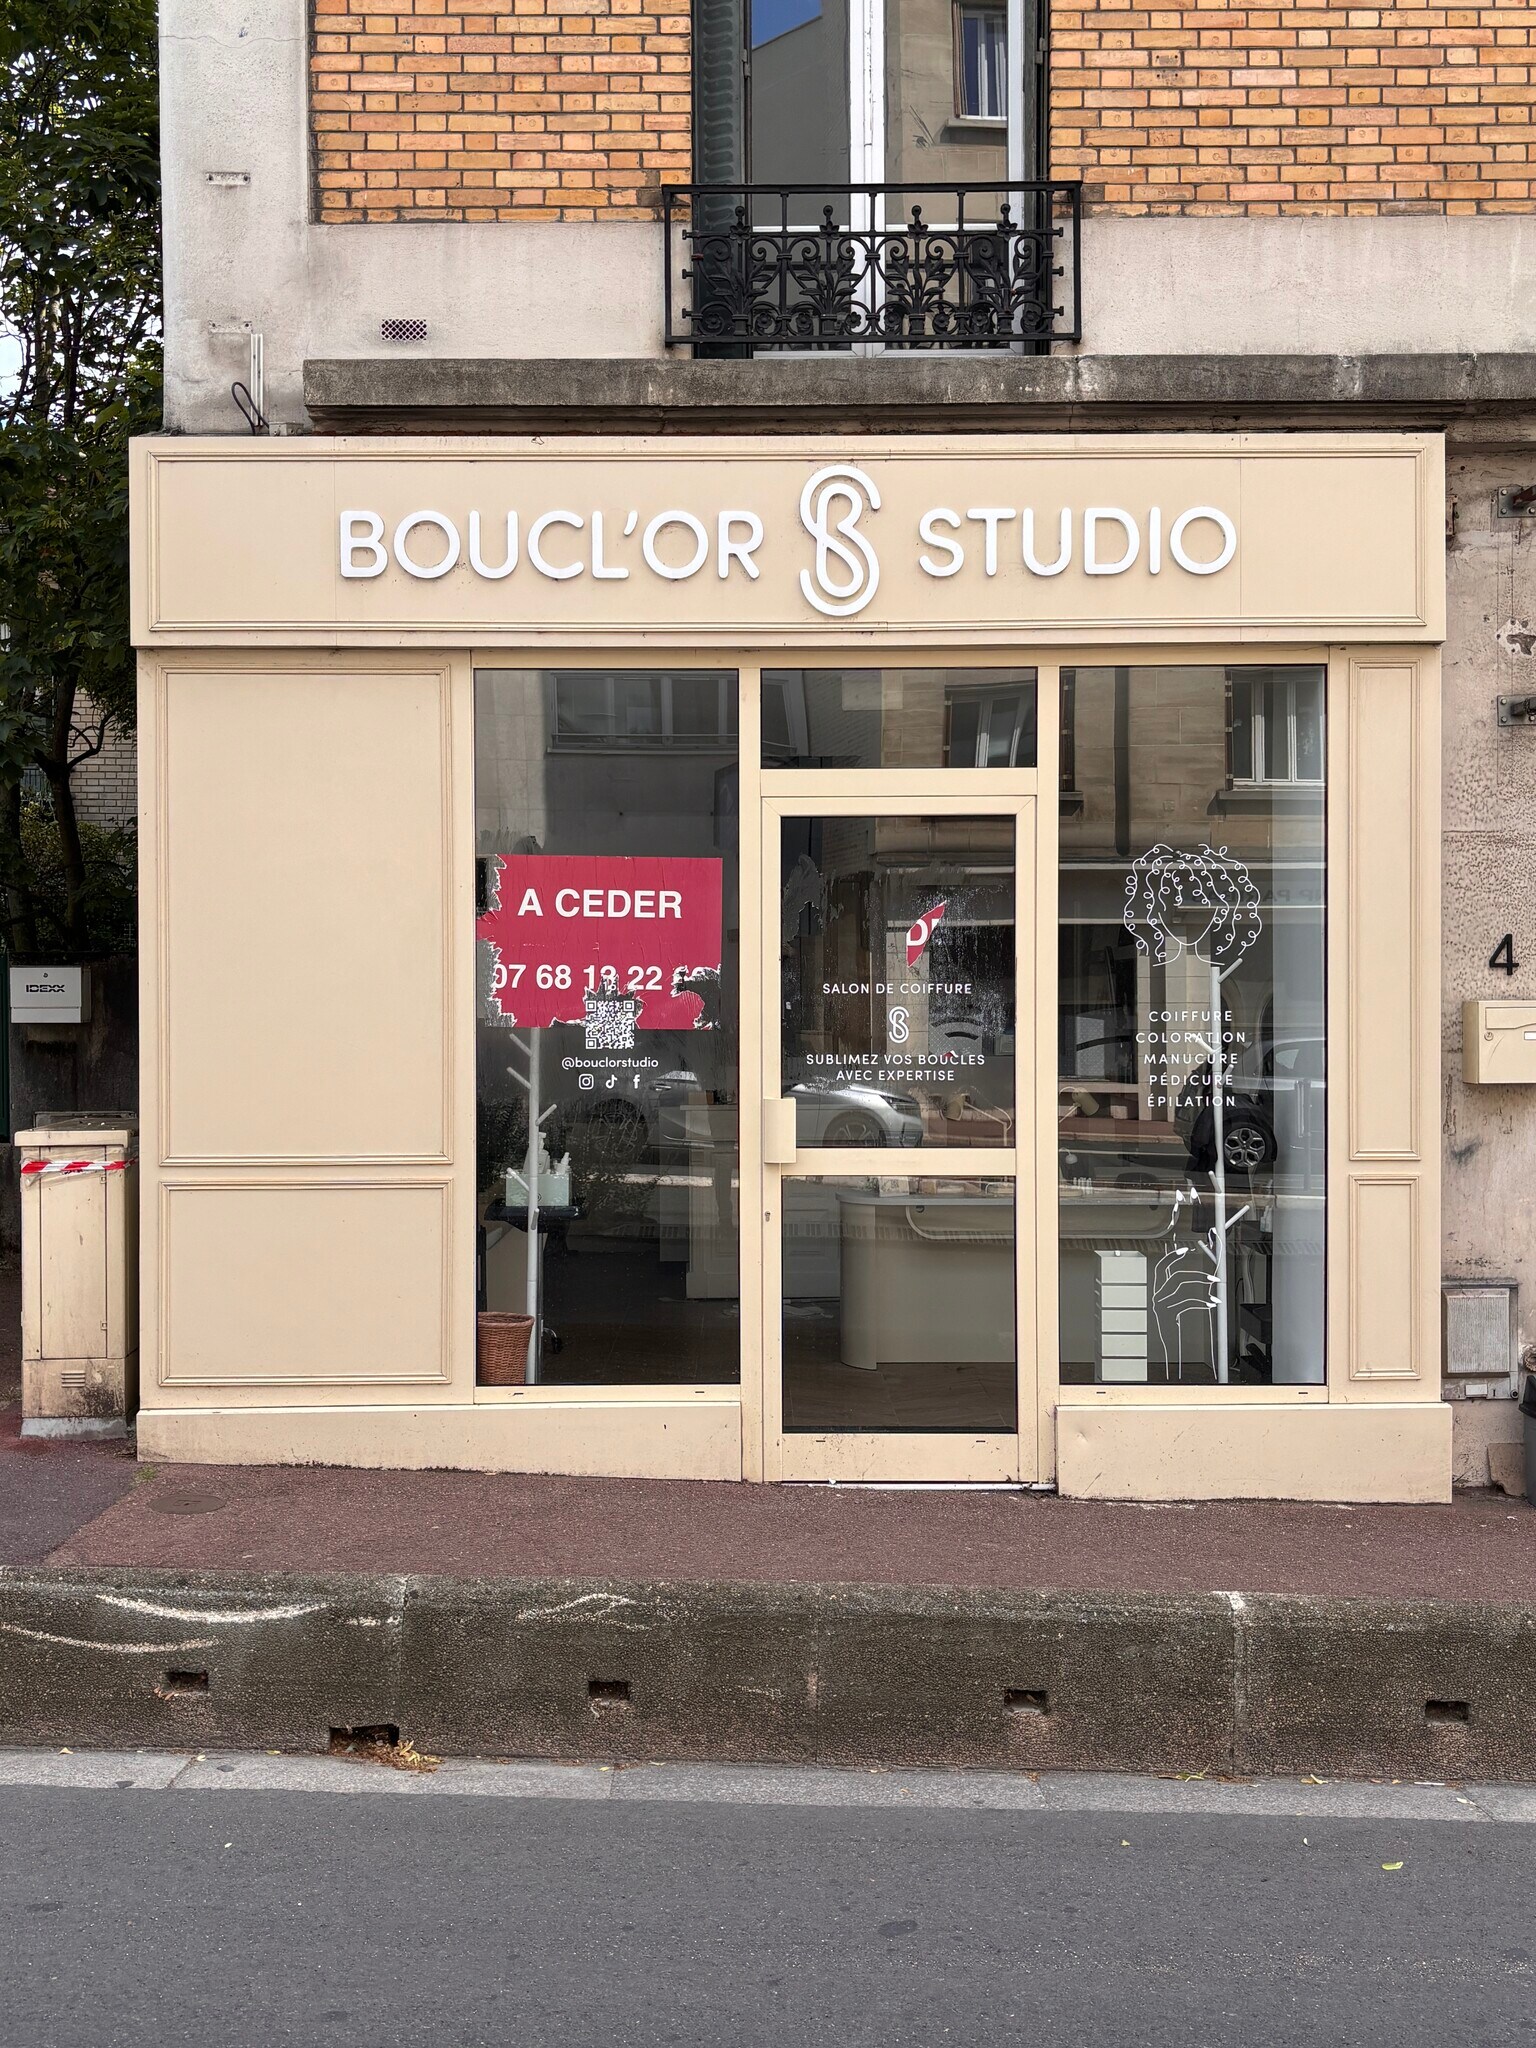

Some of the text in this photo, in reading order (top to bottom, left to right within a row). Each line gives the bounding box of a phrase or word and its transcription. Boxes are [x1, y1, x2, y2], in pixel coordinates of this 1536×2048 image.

[339, 509, 764, 580] BOUCL'OR
[917, 505, 1237, 578] STUDIO
[517, 888, 682, 918] A CEDER
[1489, 934, 1519, 976] 4
[492, 963, 527, 989] 07
[536, 964, 572, 990] 68
[627, 965, 662, 990] 22
[26, 984, 65, 993] IDEXX
[822, 983, 972, 995] SALON DE COIFFURE
[1148, 1010, 1233, 1022] COIFFURE
[1135, 1031, 1246, 1044] COLORATION
[561, 1056, 659, 1070] @bouclorstudio
[806, 1054, 985, 1066] SUBLIMEZ VOS BOUCLES
[1143, 1053, 1238, 1065] MANUCURE
[836, 1070, 955, 1081] AVEC EXPERTISE
[1149, 1072, 1233, 1086] PÉDICURE
[1147, 1093, 1236, 1107] ÉPILATION
